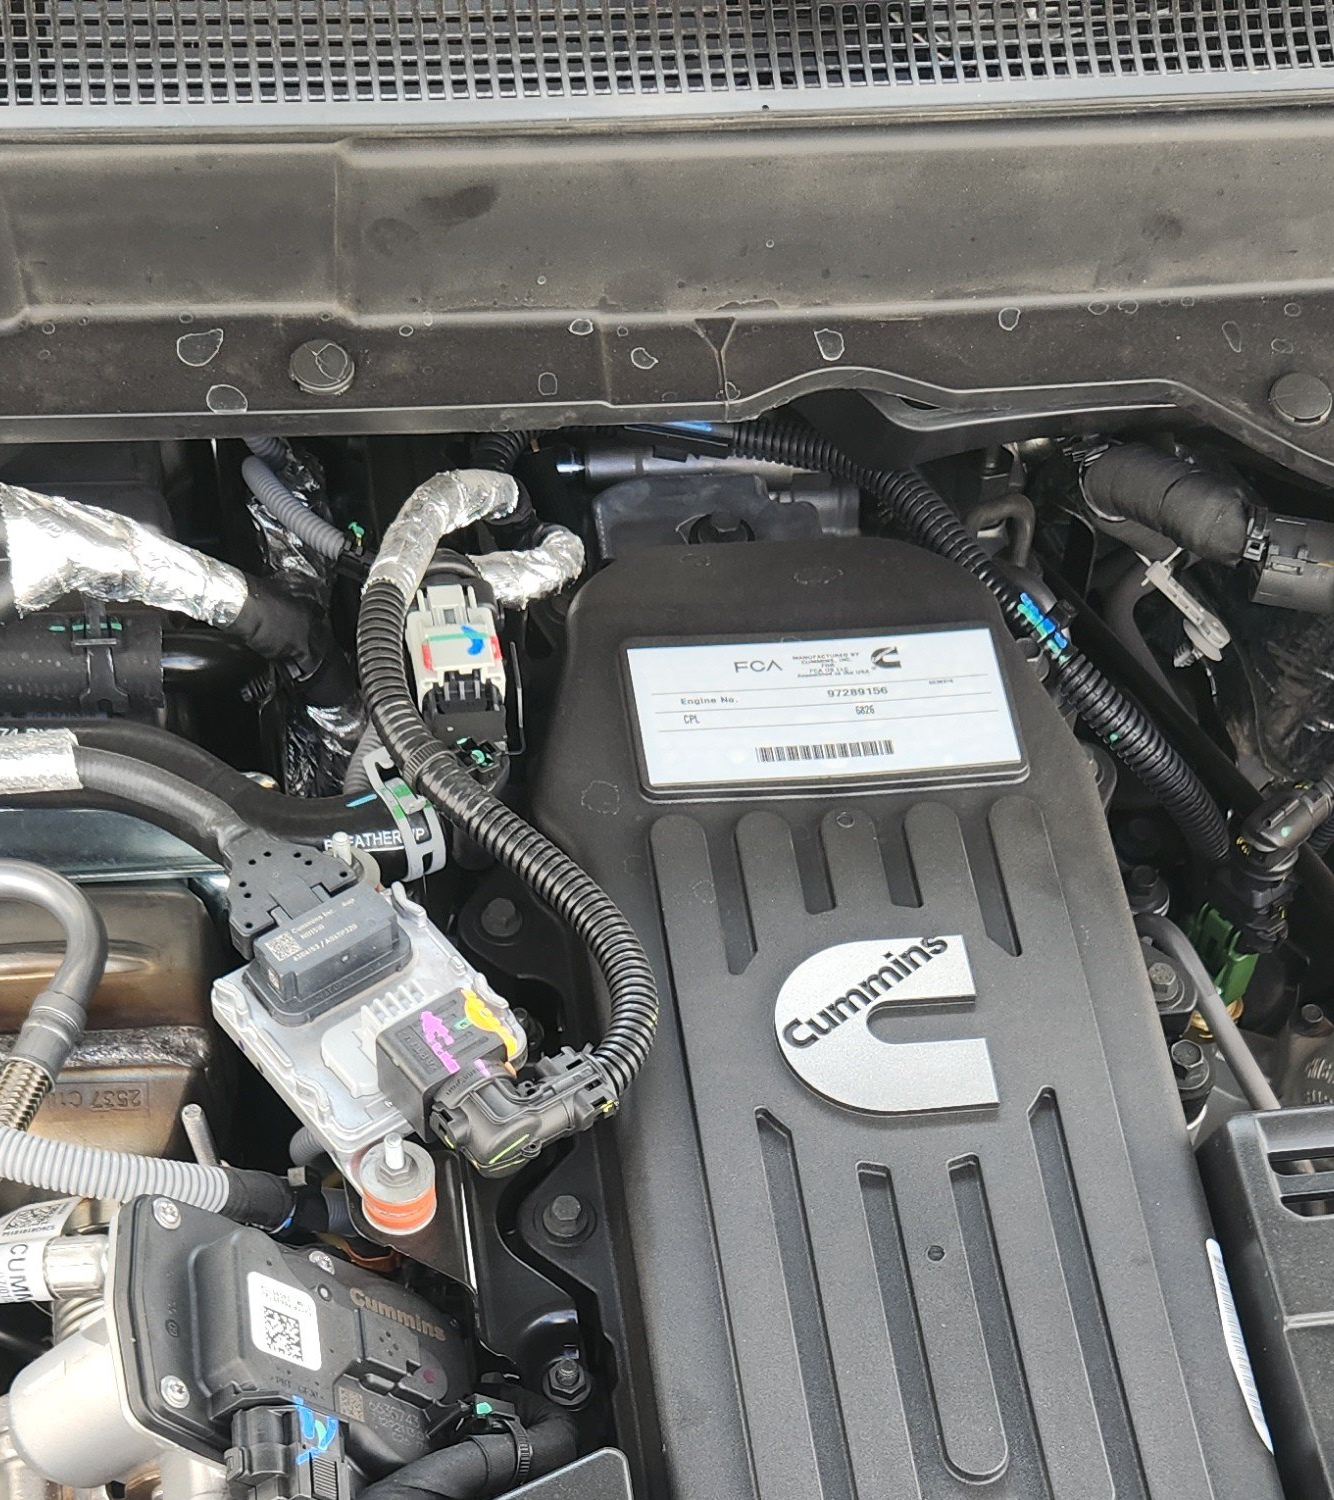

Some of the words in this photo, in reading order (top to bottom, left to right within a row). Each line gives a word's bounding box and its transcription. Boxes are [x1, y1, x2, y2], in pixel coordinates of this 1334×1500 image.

[734, 660, 783, 674] FCA
[680, 696, 717, 706] Engine
[720, 695, 739, 704] No.
[827, 686, 889, 698] 97289156
[683, 714, 701, 725] CPL
[782, 936, 948, 1049] Cummins
[91, 1089, 142, 1108] 2537
[349, 1287, 447, 1342] Cummins
